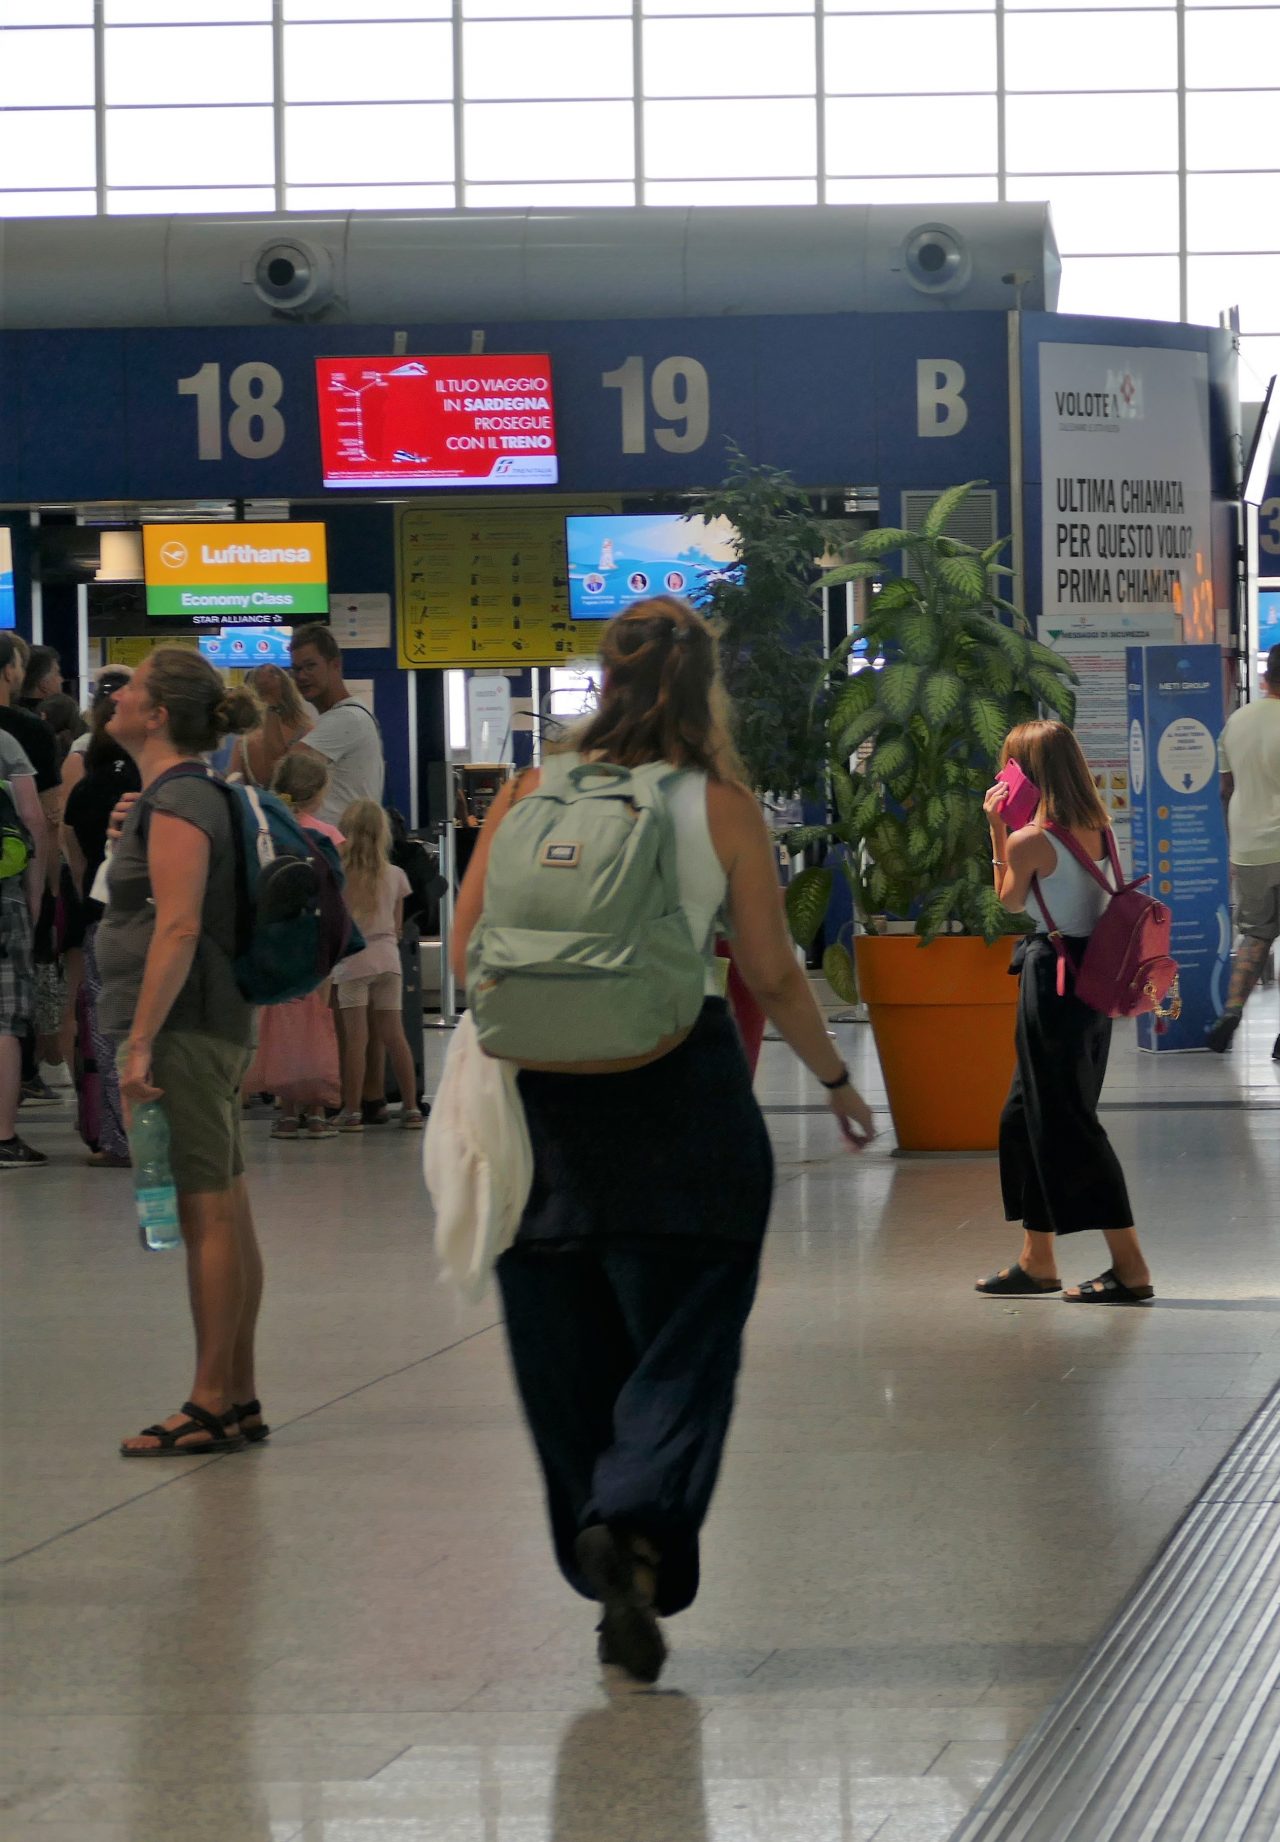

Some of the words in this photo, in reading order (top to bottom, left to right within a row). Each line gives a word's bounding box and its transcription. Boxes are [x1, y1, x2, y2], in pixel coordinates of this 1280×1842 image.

[484, 377, 549, 392] VIAGGIO
[443, 399, 462, 412] IN
[463, 397, 550, 412] SARDEGNA
[601, 356, 711, 455] 19
[916, 358, 970, 438] B
[1055, 391, 1121, 418] VOLOTEA
[177, 360, 287, 461] 18
[474, 416, 552, 430] PROSEGUE
[445, 436, 485, 450] CON
[487, 436, 500, 449] IL
[499, 435, 552, 449] TRENO
[1056, 478, 1116, 513] ULTIMA
[1120, 479, 1185, 514] CHIAMATA
[1057, 523, 1092, 557] PER
[1096, 524, 1153, 558] QUESTO
[1156, 525, 1193, 559] VOLO?
[202, 544, 311, 564] Lufthansa
[1057, 569, 1112, 602] PRIMA
[181, 593, 250, 608] Economy
[251, 592, 294, 606] Class
[193, 616, 220, 624] STAR
[221, 615, 271, 623] ALLIANCE
